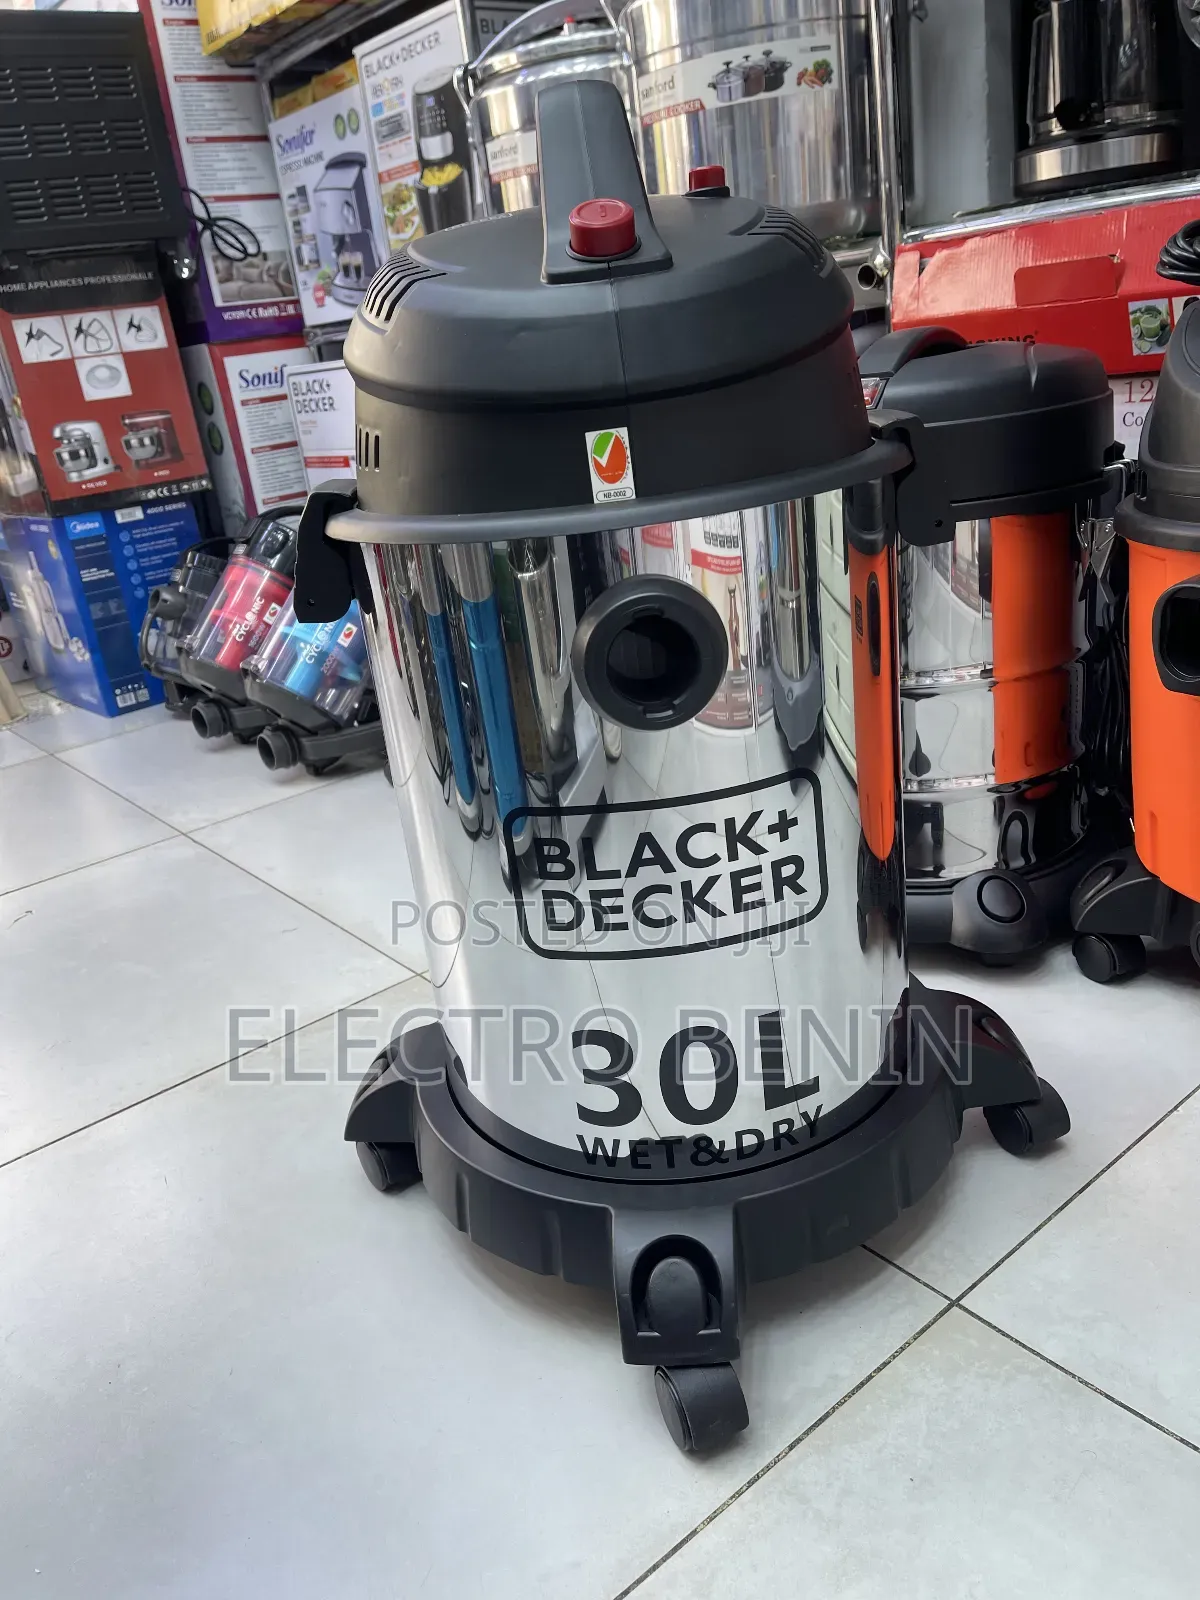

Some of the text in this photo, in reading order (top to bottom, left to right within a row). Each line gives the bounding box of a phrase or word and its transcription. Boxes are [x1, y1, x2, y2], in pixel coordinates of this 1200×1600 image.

[641, 74, 676, 100] sanford
[0, 282, 27, 293] HOME
[28, 277, 84, 291] APPLIANCES
[291, 377, 331, 397] BLACK+
[295, 396, 336, 414] DECKER
[603, 489, 627, 499] NB-0002
[533, 808, 799, 881] BLACK+
[540, 854, 808, 932] DECKER
[571, 1010, 821, 1129] 30L
[576, 1104, 824, 1170] WET&DRY
